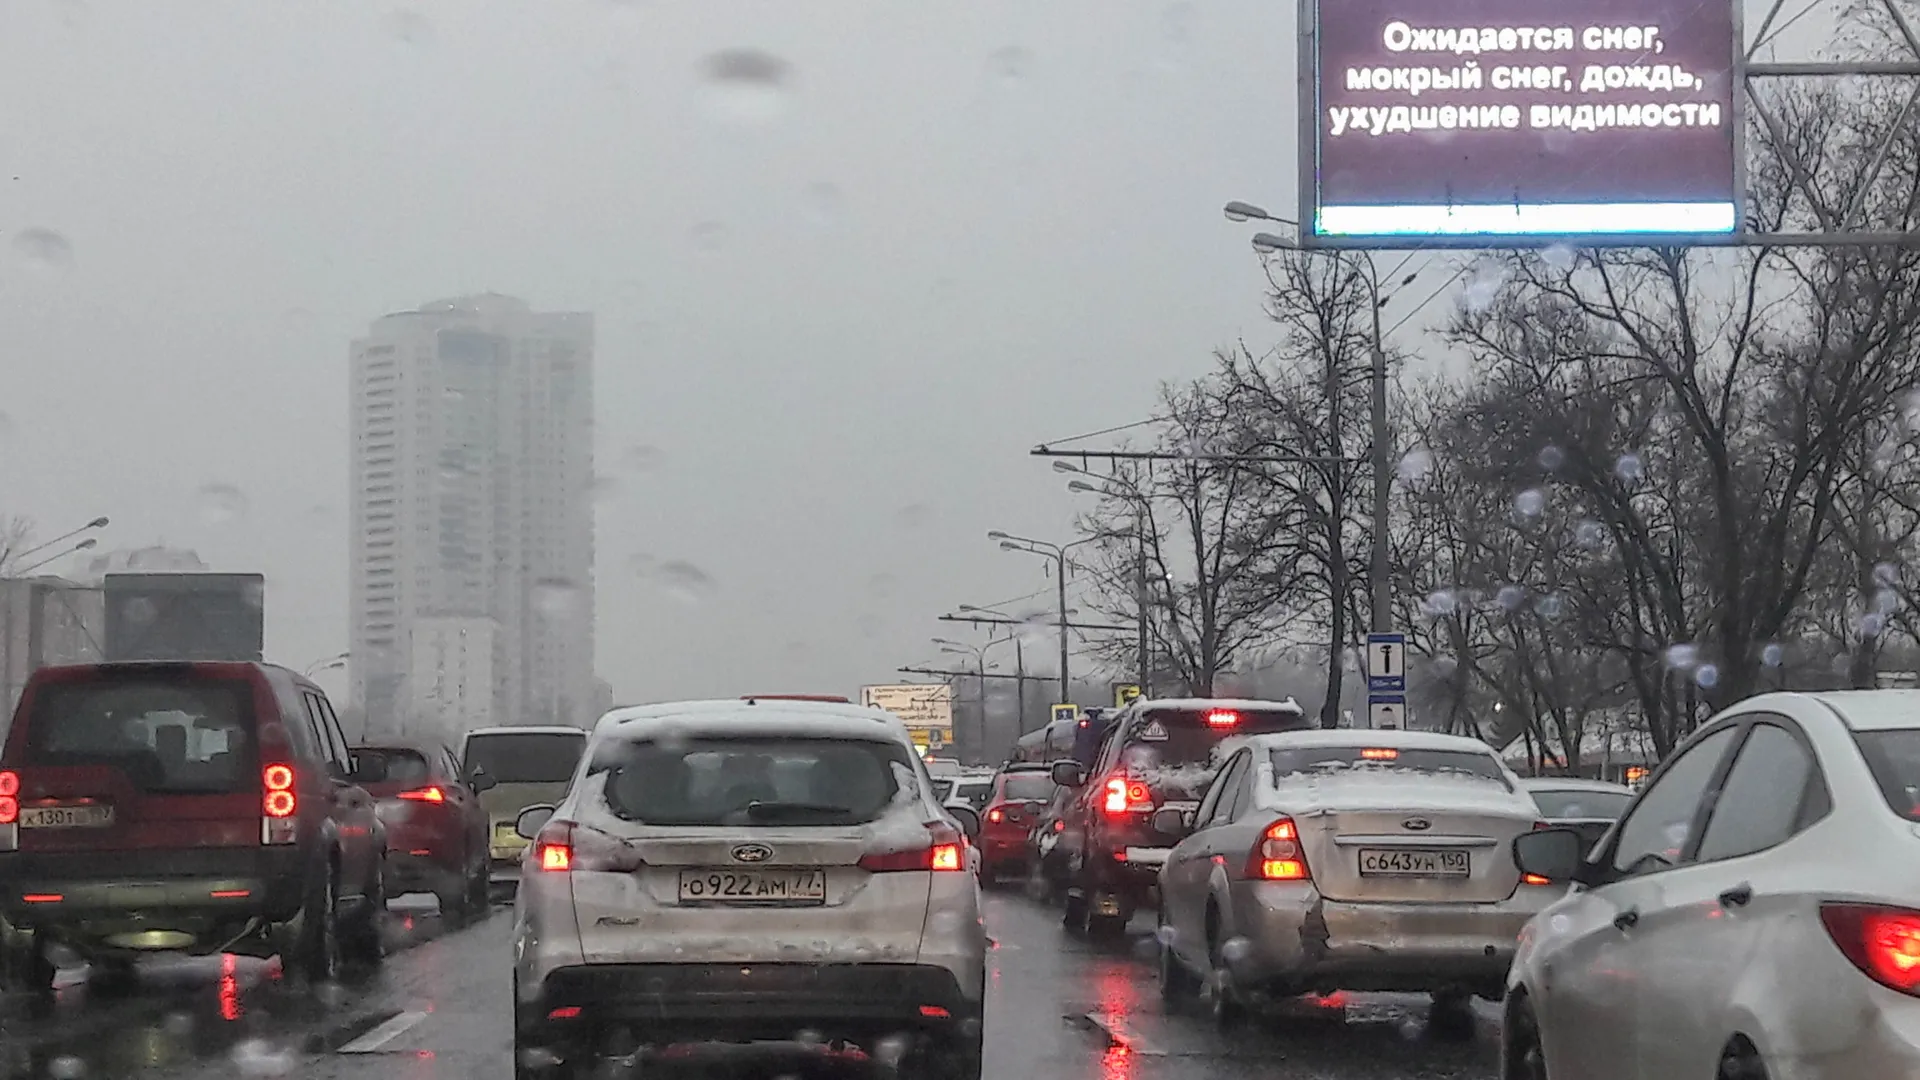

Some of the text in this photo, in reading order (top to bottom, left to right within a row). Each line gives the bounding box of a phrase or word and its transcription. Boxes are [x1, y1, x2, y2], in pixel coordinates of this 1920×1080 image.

[1383, 21, 1664, 54] Ожидается снег,
[1346, 61, 1703, 95] мокрый снег, дождь,
[1329, 104, 1720, 135] ухудшение видимости
